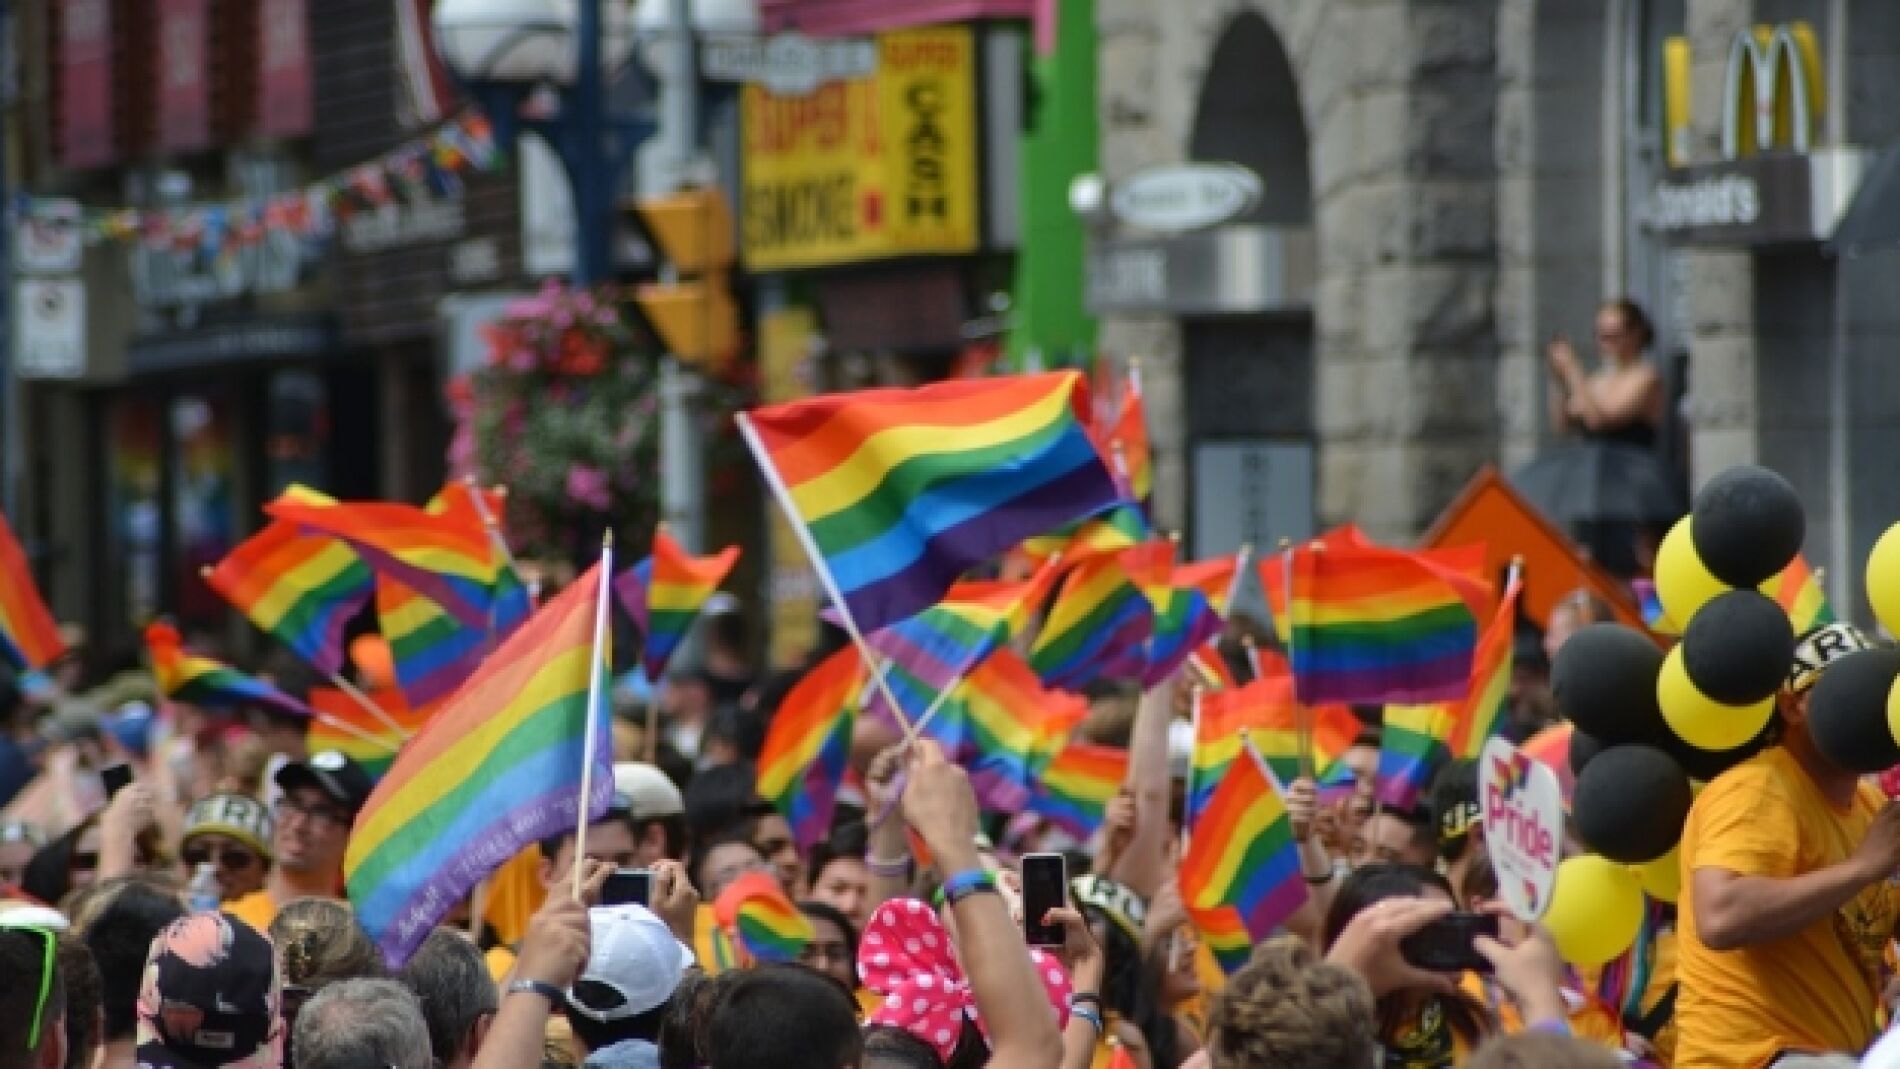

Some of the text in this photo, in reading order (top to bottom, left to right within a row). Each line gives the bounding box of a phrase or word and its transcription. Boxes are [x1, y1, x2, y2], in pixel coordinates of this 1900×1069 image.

[902, 81, 949, 223] CASH
[743, 172, 855, 249] SMOKE
[1485, 783, 1554, 872] Pride
